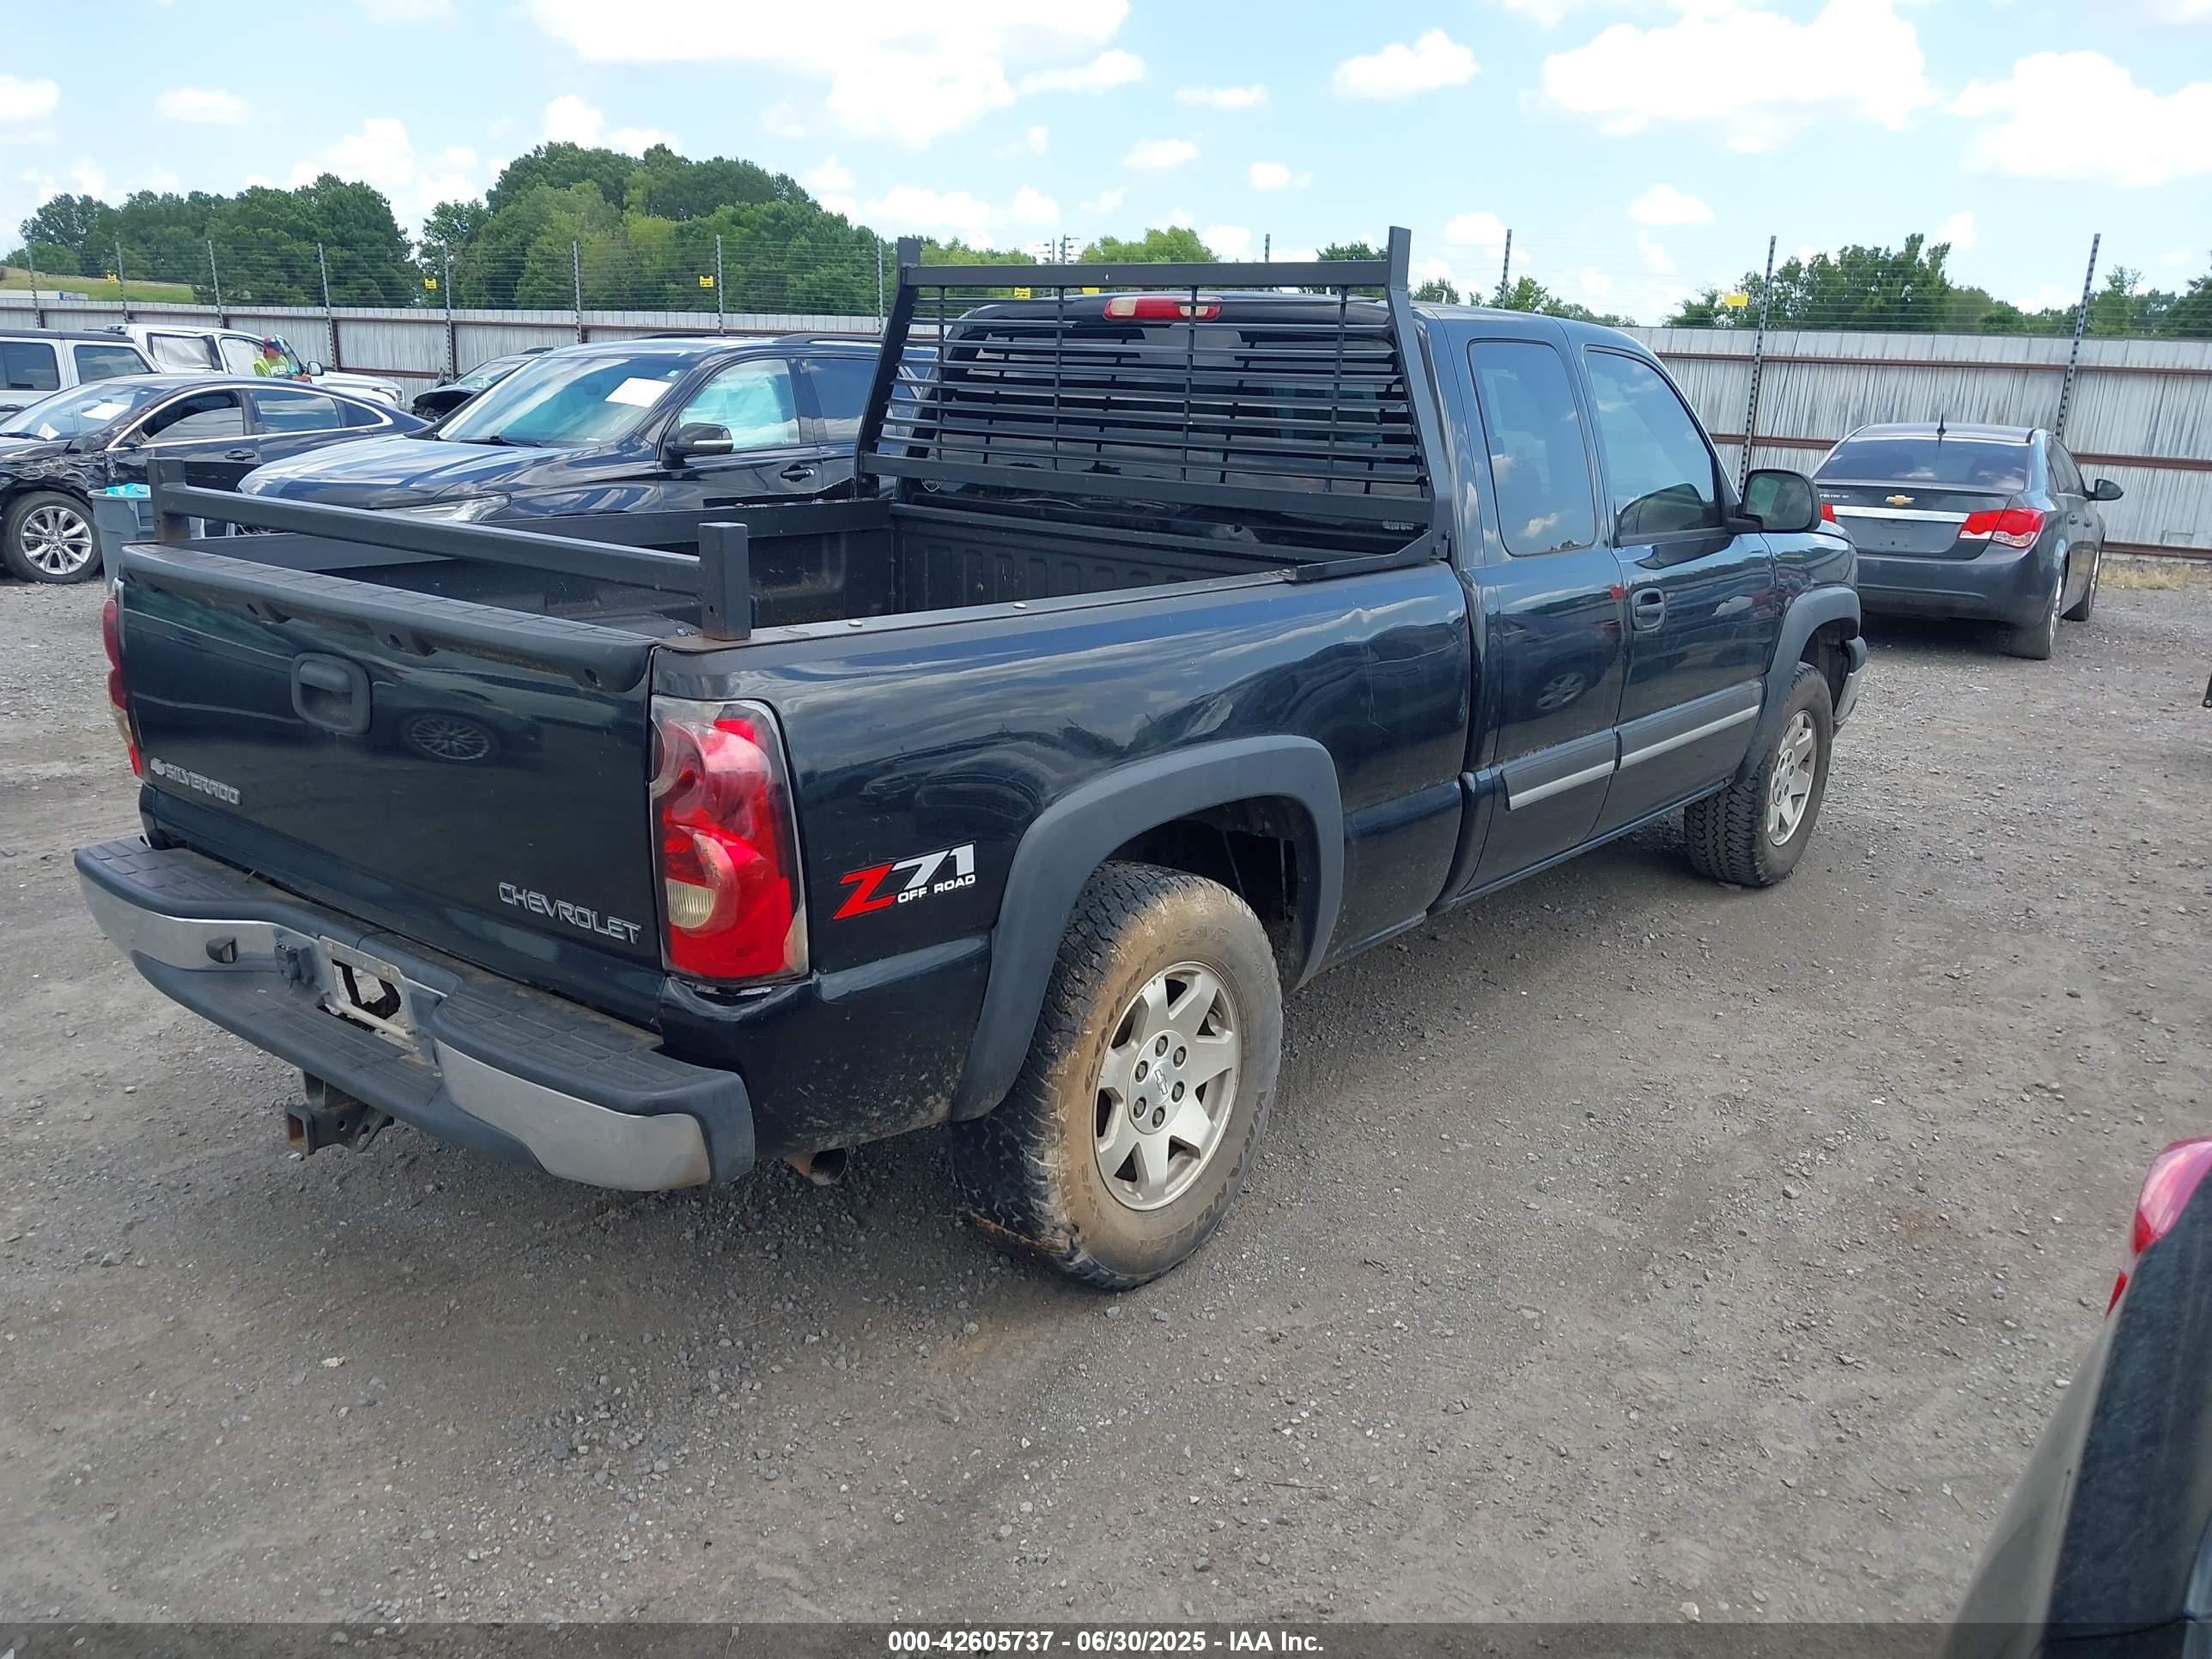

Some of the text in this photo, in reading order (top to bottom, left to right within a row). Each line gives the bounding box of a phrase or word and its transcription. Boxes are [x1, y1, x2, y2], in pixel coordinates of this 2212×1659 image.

[164, 762, 241, 805] SILVERADO
[832, 843, 975, 921] Z71
[897, 874, 976, 904] OFF ROAD
[498, 881, 642, 945] CHEVROLET
